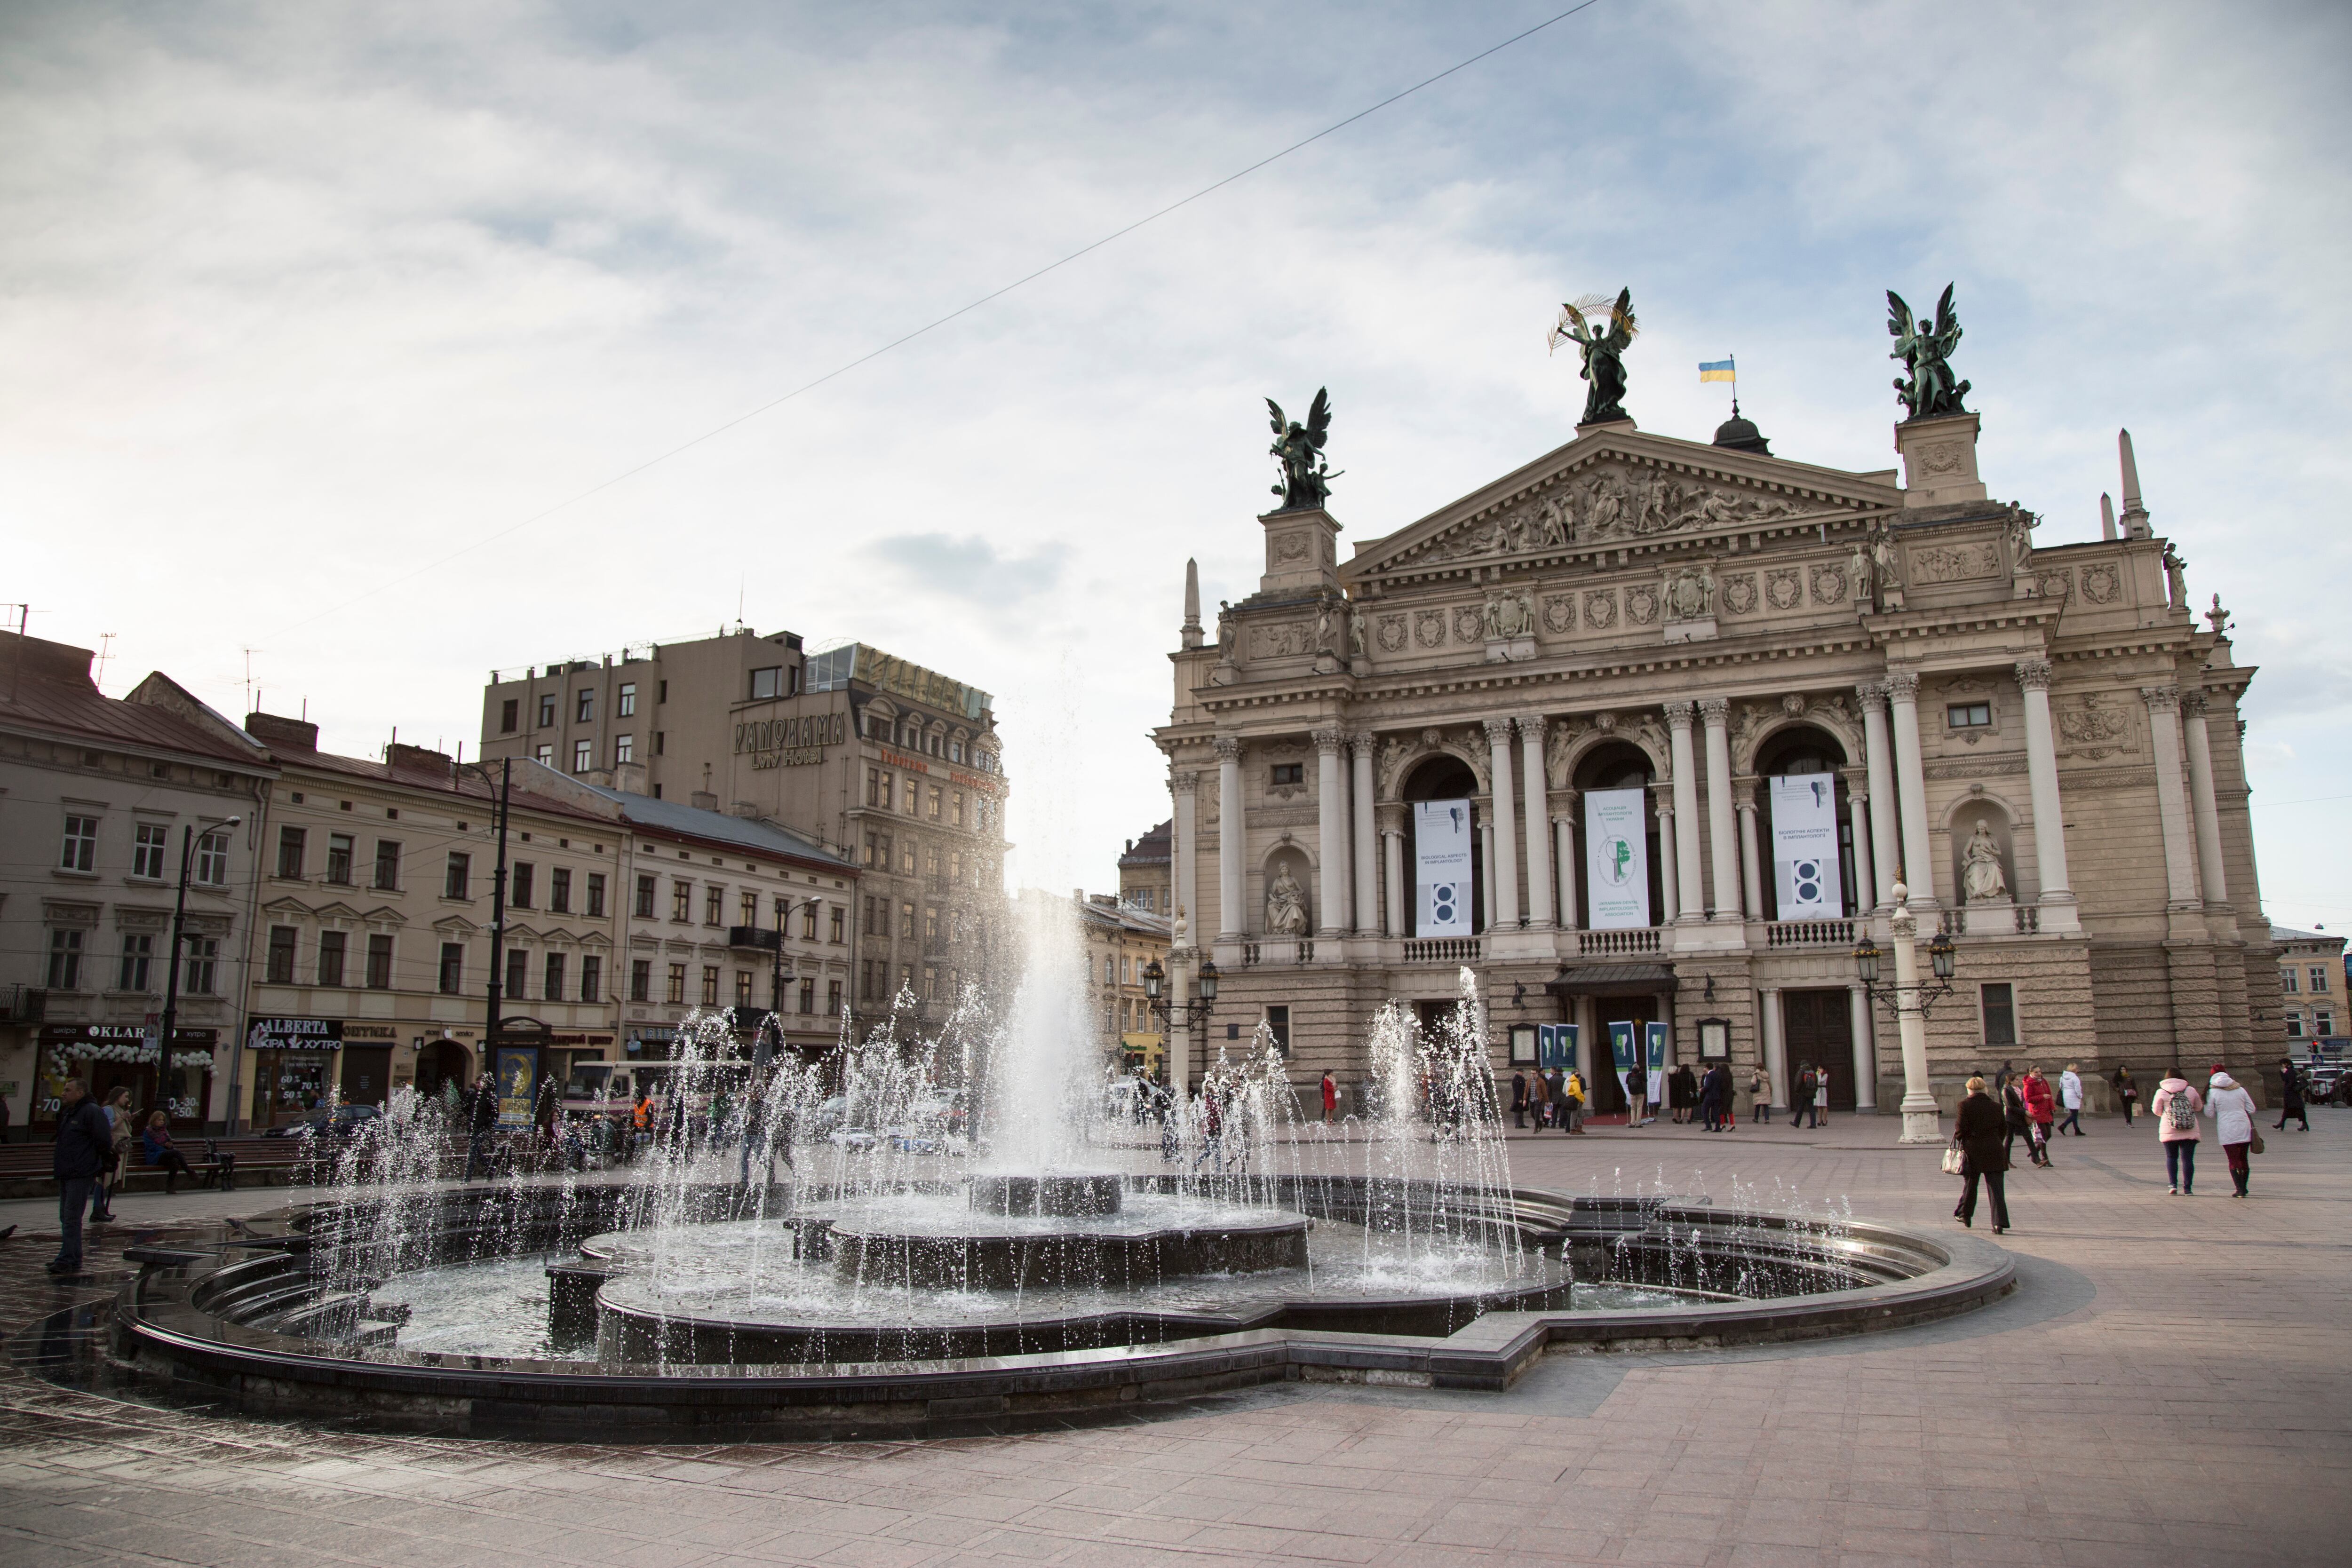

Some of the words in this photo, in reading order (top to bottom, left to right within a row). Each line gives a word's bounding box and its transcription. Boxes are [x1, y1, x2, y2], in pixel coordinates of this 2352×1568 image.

[734, 712, 844, 753] PANORAMA
[751, 753, 779, 769] Lviv
[783, 747, 822, 766] Hotel
[264, 1019, 328, 1034] ALBERTA
[342, 1026, 397, 1037] ОПТИКА
[303, 1040, 342, 1050] ХУТРО
